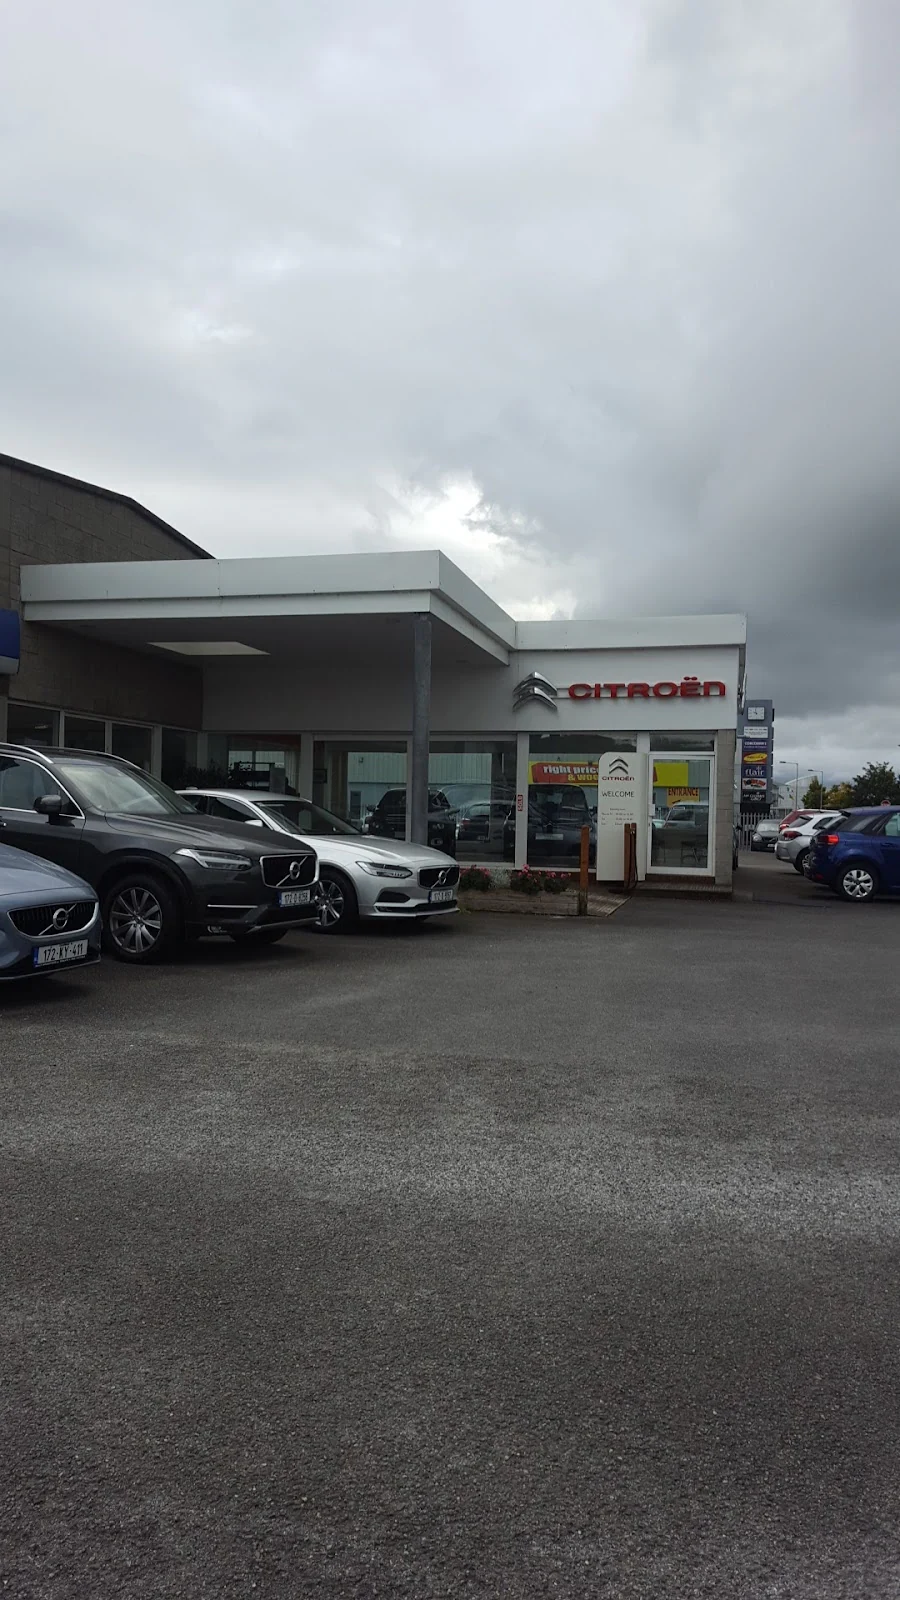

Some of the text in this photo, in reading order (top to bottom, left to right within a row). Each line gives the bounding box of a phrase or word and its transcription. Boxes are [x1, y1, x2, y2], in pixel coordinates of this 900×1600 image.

[568, 676, 726, 699] CITROËN
[543, 765, 599, 774] right pric
[668, 787, 699, 796] ENTRANCE
[43, 944, 84, 962] 172-KY-411
